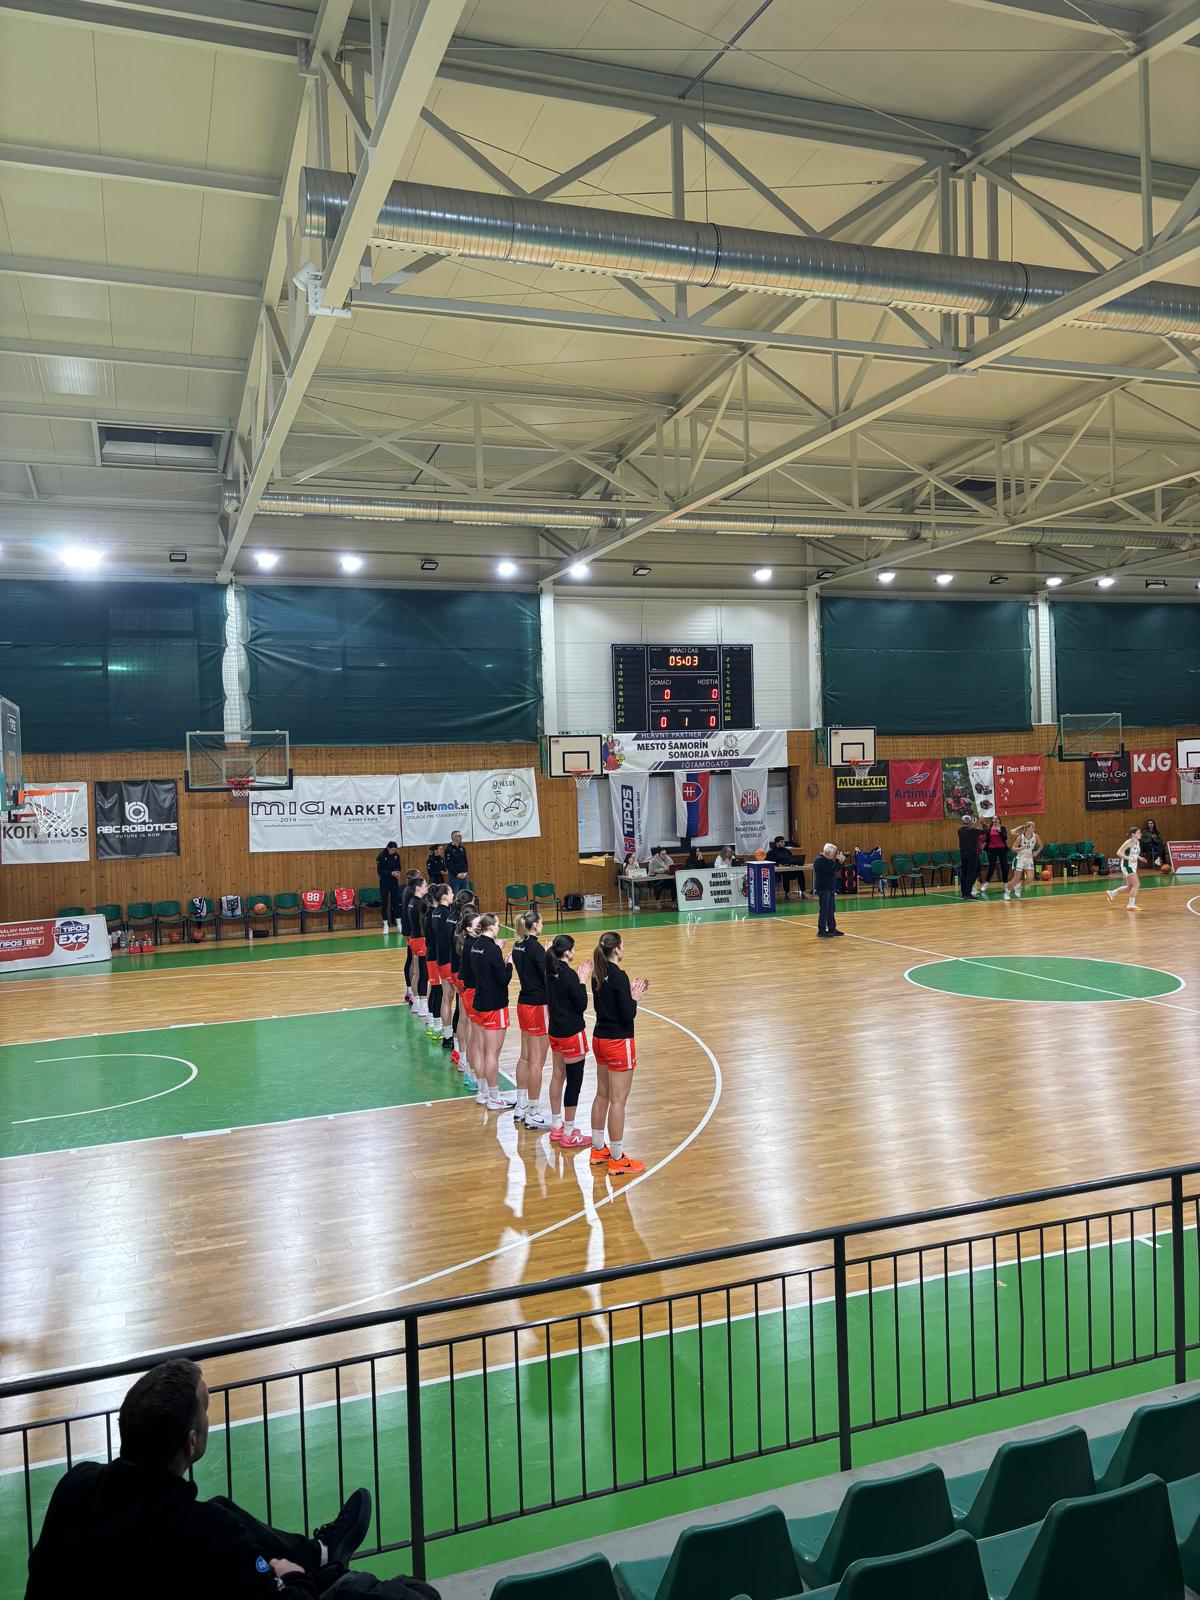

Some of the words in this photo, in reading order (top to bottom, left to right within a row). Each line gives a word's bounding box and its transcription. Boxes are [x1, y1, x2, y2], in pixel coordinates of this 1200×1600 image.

[669, 656, 698, 666] 05:03
[664, 690, 670, 699] 0
[712, 689, 718, 698] 0
[661, 717, 667, 727] 0
[686, 717, 688, 726] 1
[710, 716, 716, 726] 0
[637, 742, 666, 750] MESTO
[668, 740, 708, 750] ŠAMORÍN
[668, 750, 709, 759] SOMORJA
[711, 748, 739, 757] VÁROS
[1133, 753, 1172, 772] KJG
[838, 777, 885, 787] MUREXIN
[742, 789, 758, 807] SBA
[895, 789, 937, 799] Artimus
[417, 800, 470, 811] bitumat.sk
[1140, 796, 1167, 804] QUALITY
[252, 801, 324, 815] mia
[330, 804, 395, 816] MARKET
[622, 788, 634, 835] TIPOS
[97, 825, 121, 834] ABC
[122, 822, 178, 833] ROBOTICS
[307, 893, 319, 901] 88
[59, 934, 88, 944] EXZ
